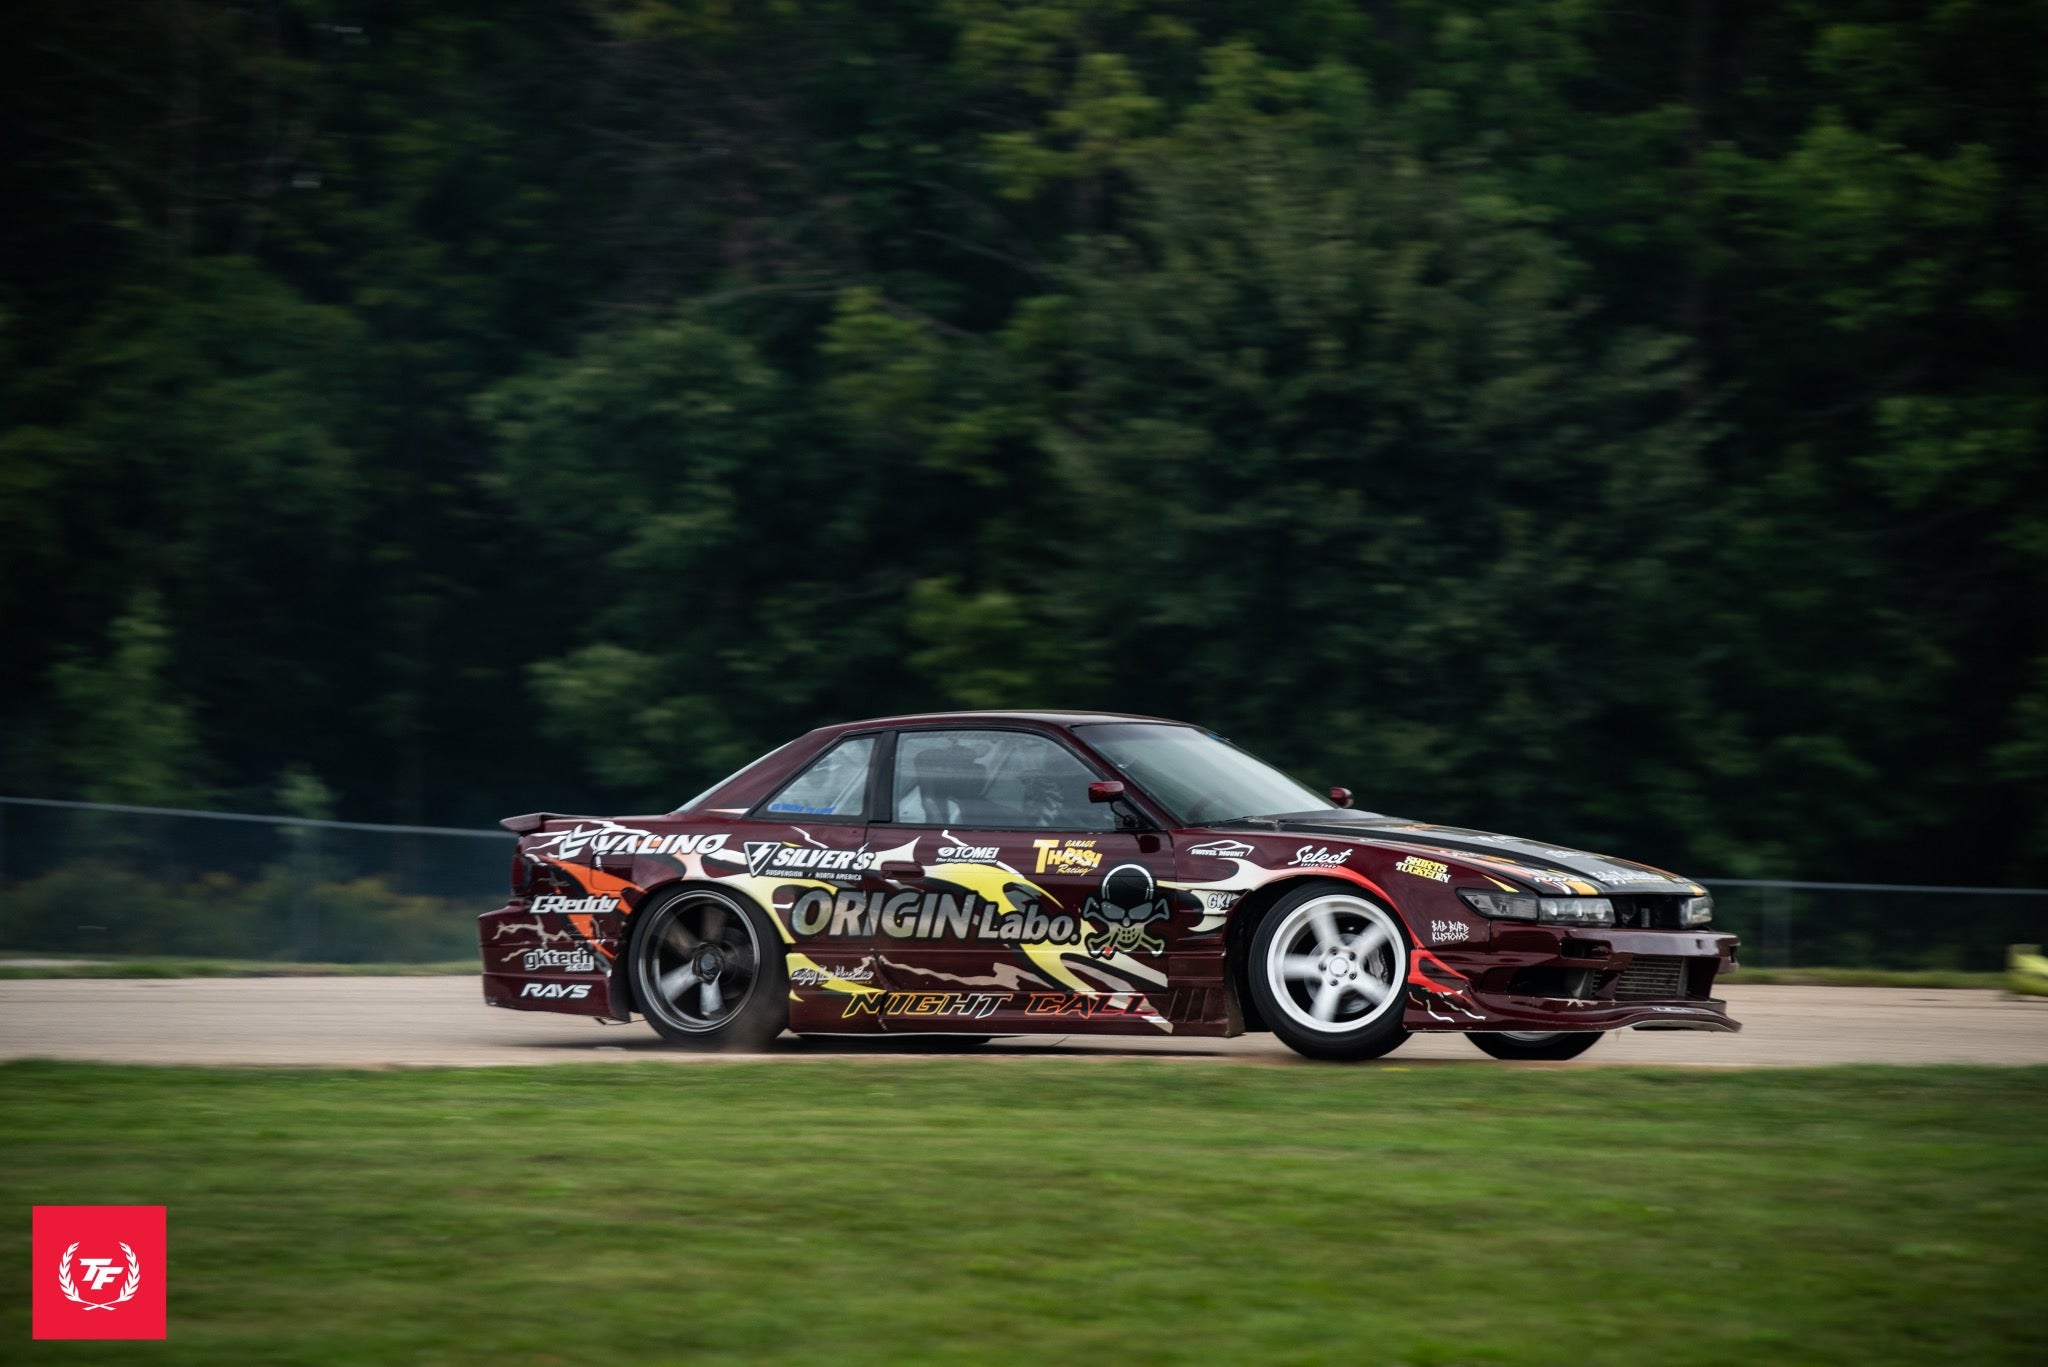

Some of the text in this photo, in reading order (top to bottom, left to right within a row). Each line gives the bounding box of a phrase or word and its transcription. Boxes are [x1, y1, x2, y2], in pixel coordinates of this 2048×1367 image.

[597, 834, 732, 855] VALINO
[1064, 840, 1096, 848] GARAGE
[954, 846, 1000, 859] TOMEI
[1287, 844, 1353, 866] Select
[765, 869, 803, 878] SUSPENSION
[836, 873, 862, 881] AMERICA
[1056, 864, 1093, 877] Racing
[793, 889, 975, 938] ORIGIN
[520, 983, 592, 998] RAYS
[842, 992, 1158, 1019] NIGHT CALL
